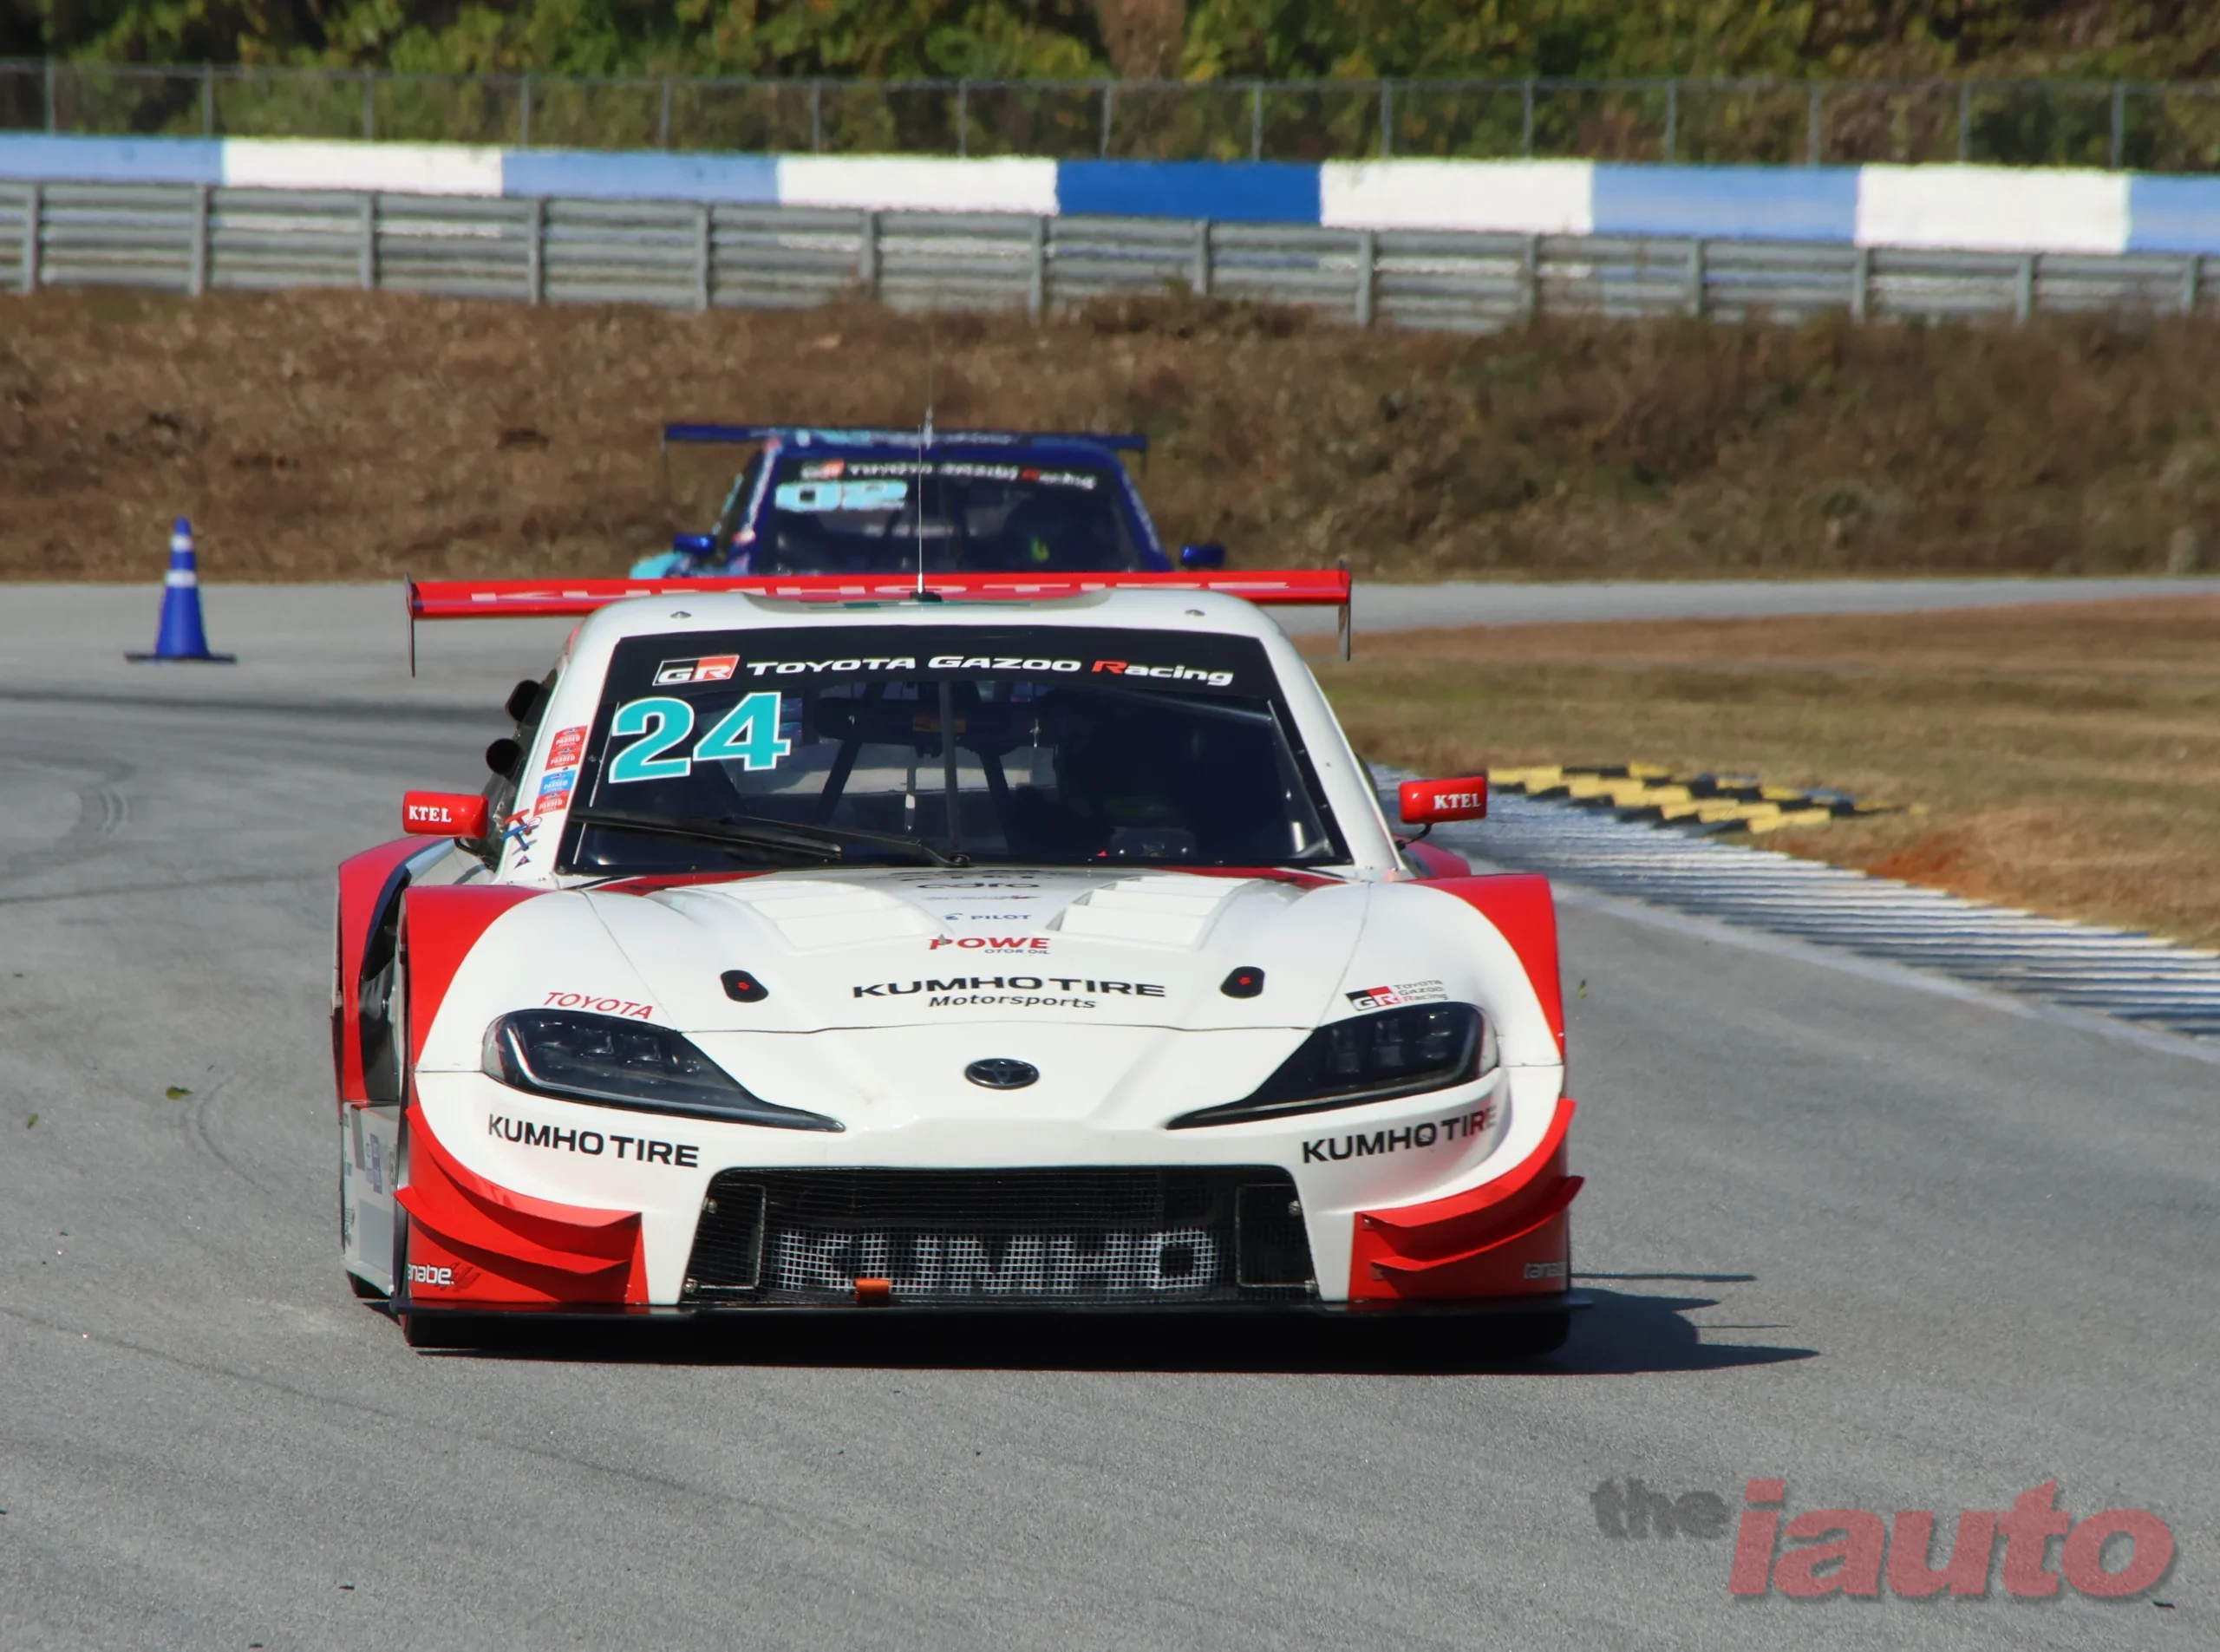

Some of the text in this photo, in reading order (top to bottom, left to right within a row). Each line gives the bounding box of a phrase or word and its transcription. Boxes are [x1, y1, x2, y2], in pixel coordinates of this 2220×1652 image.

[655, 656, 1234, 687] GR TOYOTA GAZOO Racing
[609, 692, 792, 784] 24
[408, 805, 453, 823] KTEL
[1433, 793, 1482, 810] KTEL
[852, 976, 1166, 998] KUMHO TIRE
[543, 991, 654, 1020] TOYOTA
[928, 992, 1097, 1009] Motorsports
[1350, 990, 1402, 1012] GR
[488, 1113, 700, 1168] KUMHO TIRE
[1303, 1106, 1497, 1164] KUMHO TIRE
